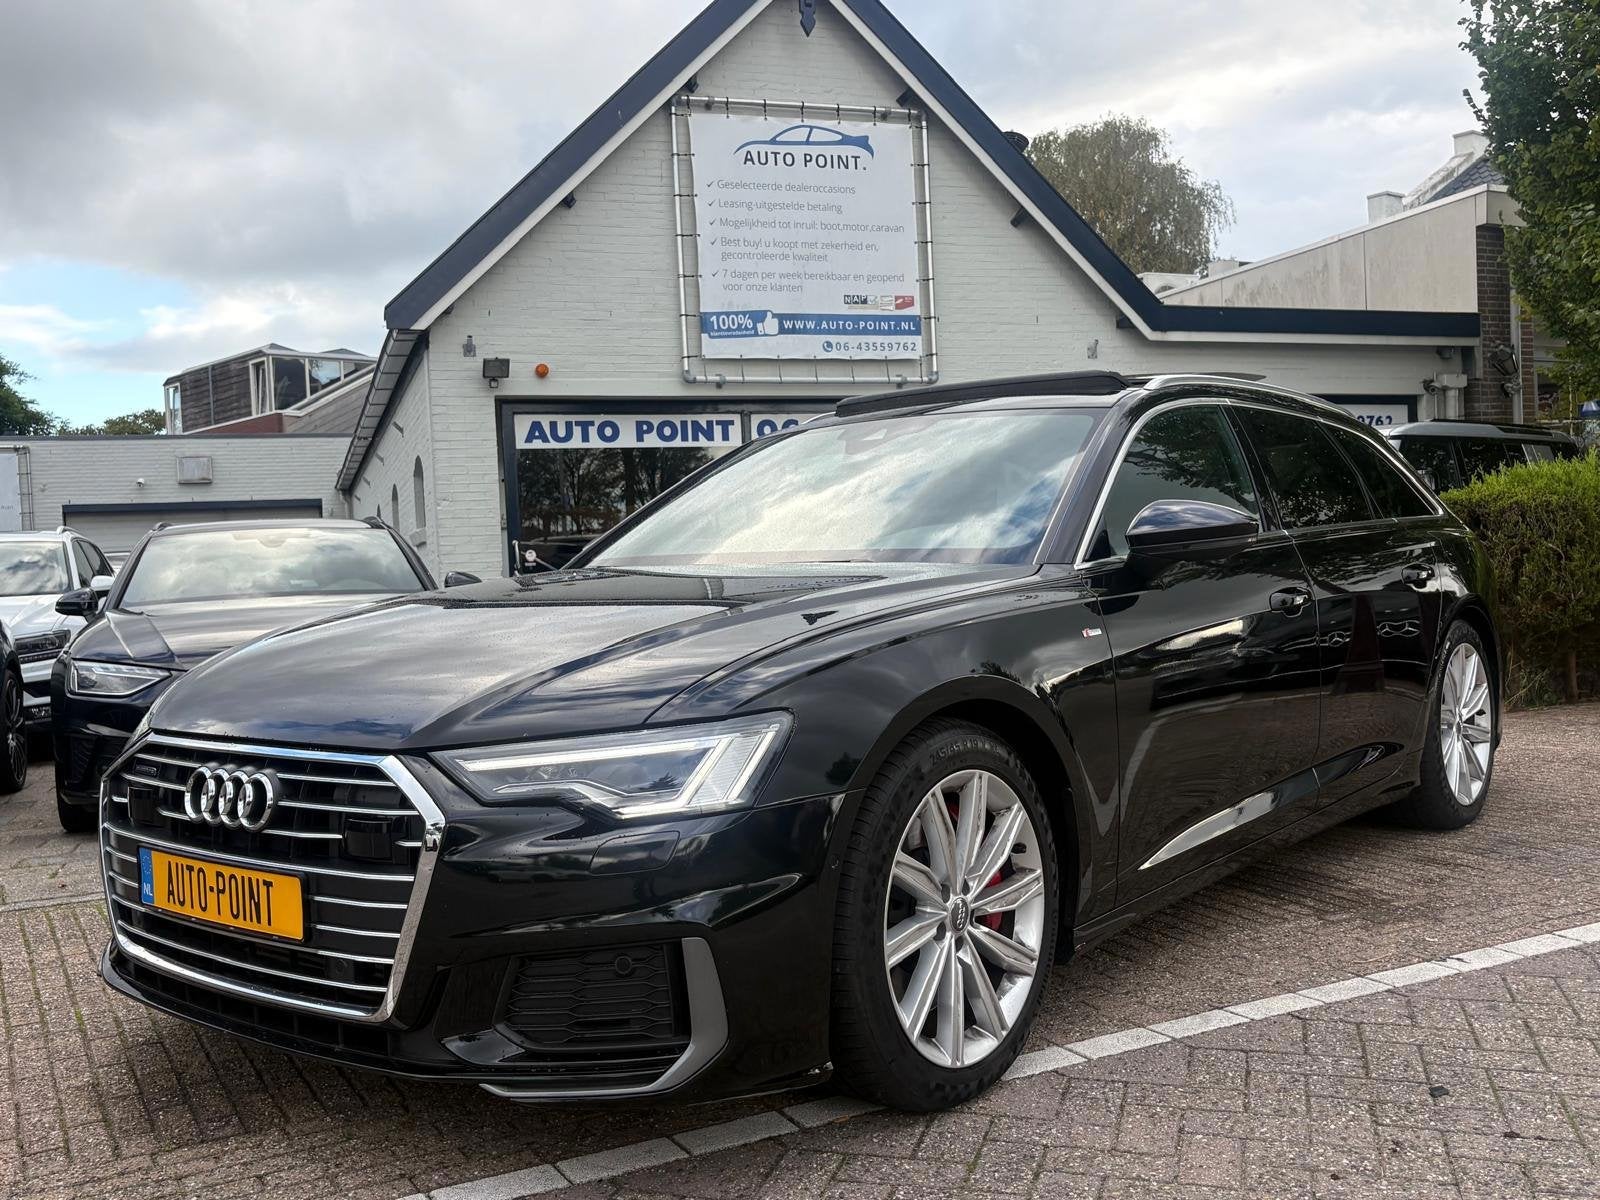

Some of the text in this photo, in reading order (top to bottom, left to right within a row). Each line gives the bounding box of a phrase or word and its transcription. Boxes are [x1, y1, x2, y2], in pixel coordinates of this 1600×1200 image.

[743, 150, 867, 171] AUTO POINT.
[717, 179, 856, 194] Geselecteerde dealeroccasions
[807, 202, 843, 214] betaling
[720, 218, 776, 230] Mogelijkheid
[778, 221, 791, 229] tot
[794, 220, 818, 230] inruil:
[720, 236, 741, 247] Best
[743, 237, 763, 250] buy!
[764, 240, 771, 248] u
[773, 237, 799, 250] koopt
[801, 241, 819, 250] met
[821, 241, 863, 251] zekerheid
[721, 251, 829, 262] gecontroleerde kwaliteit
[722, 269, 728, 278] 7
[730, 269, 759, 281] dagen
[761, 271, 776, 281] per
[779, 270, 803, 280] week
[804, 271, 851, 281] bereikbaar
[866, 273, 905, 285] geopend
[723, 283, 803, 292] voor onze klanten
[710, 313, 754, 330] 100%
[783, 319, 917, 331] WWW.AUTO-POINT.NL
[835, 341, 917, 352] 06-43559762
[524, 419, 621, 443] AUTO
[635, 419, 735, 443] POINT
[143, 882, 153, 896] NL
[167, 860, 274, 926] AUTO-POINT
